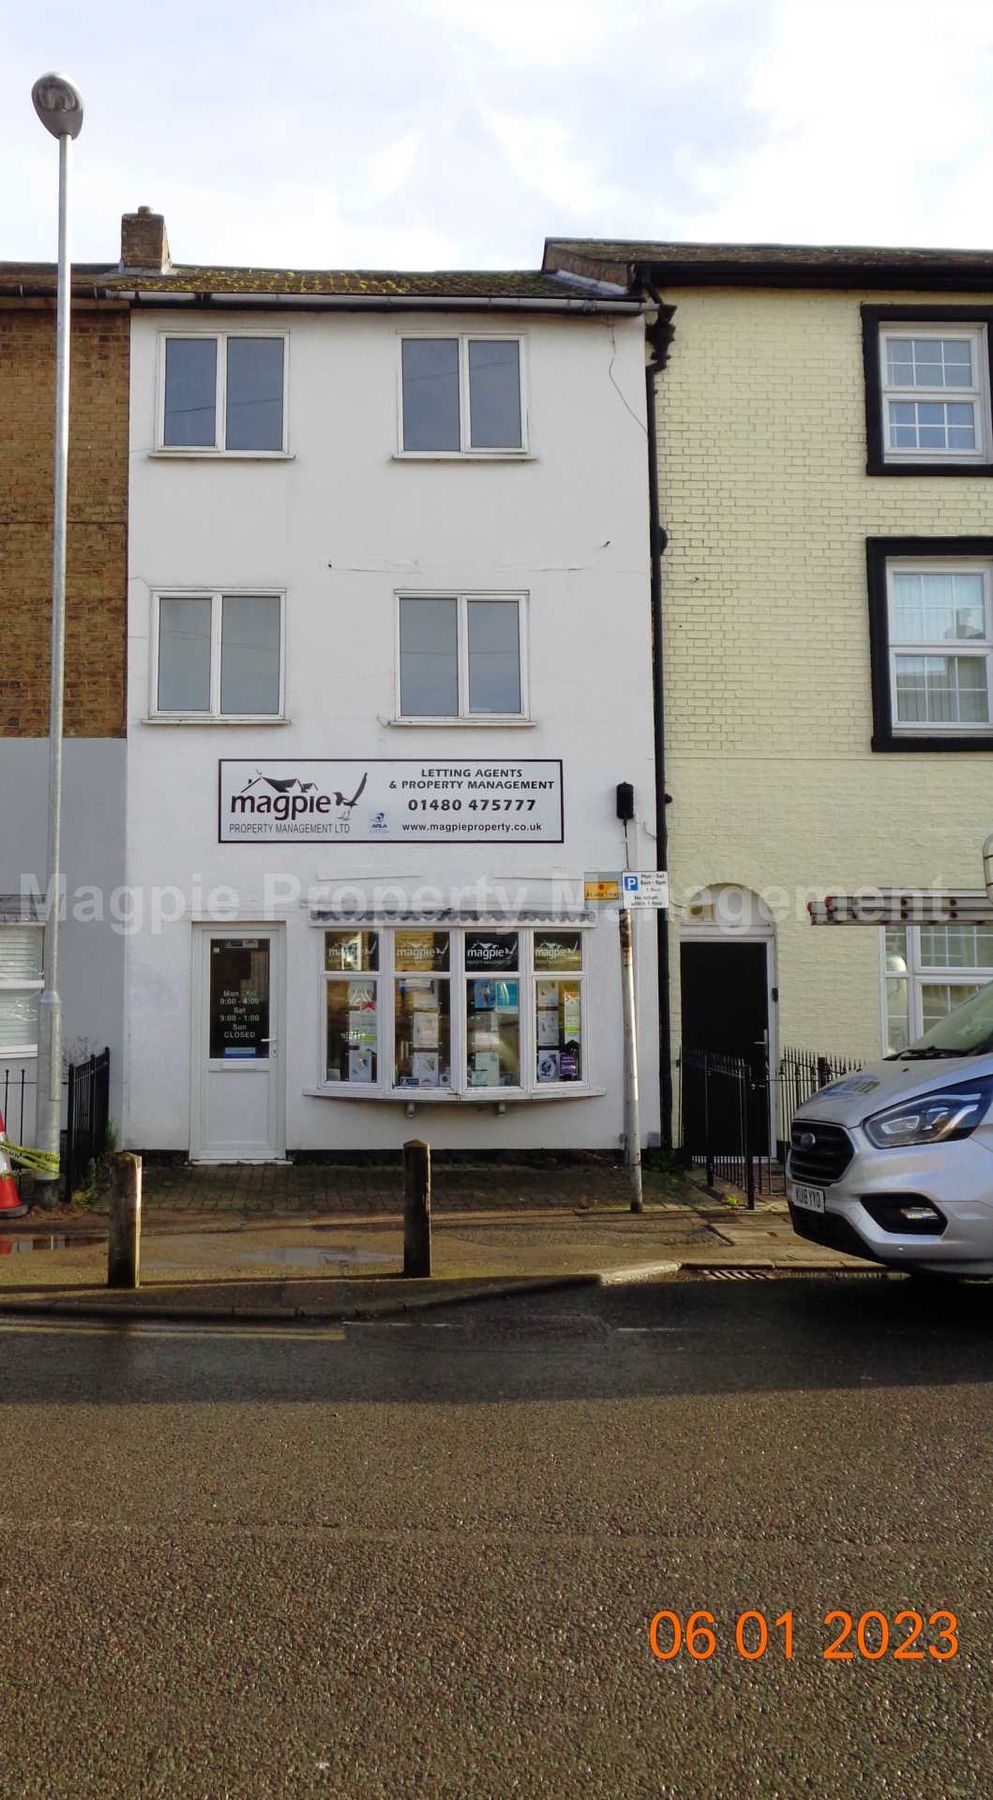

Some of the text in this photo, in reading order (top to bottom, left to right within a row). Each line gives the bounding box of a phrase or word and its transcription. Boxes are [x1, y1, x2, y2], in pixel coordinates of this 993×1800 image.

[421, 769, 523, 777] LETTING AGENTS
[389, 781, 554, 789] & PROPERTY MANAGEMENT
[230, 795, 332, 821] magpie
[408, 799, 536, 811] 01480 475777
[229, 823, 350, 834] PROPERTY MANAGEMENT LTD
[402, 822, 542, 833] www.magpieproperty.co.uk
[627, 878, 636, 889] P
[396, 947, 436, 960] magpie
[467, 948, 505, 960] magpie
